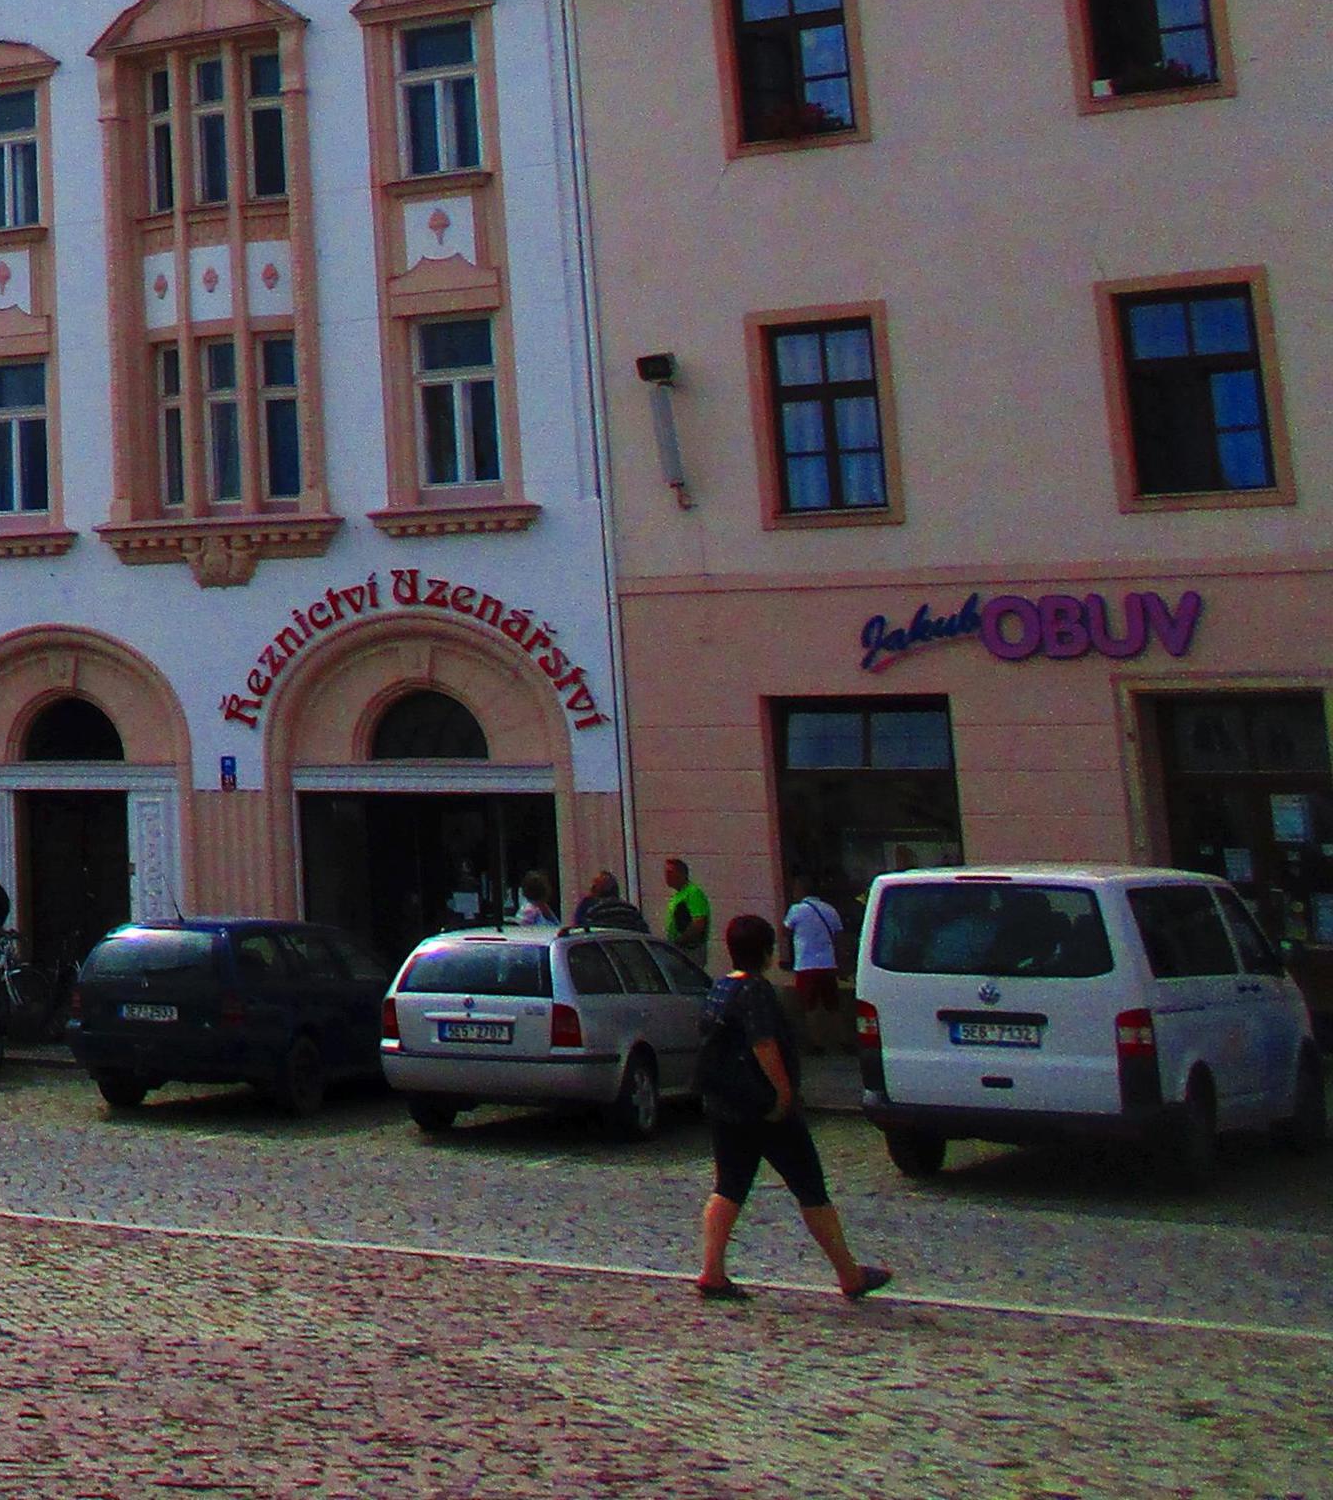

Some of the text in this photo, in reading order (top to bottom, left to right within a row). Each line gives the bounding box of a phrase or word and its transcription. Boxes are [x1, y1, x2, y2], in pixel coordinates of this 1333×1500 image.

[218, 568, 612, 732] Řeznictví Uzenářství
[980, 590, 1202, 660] OBUV
